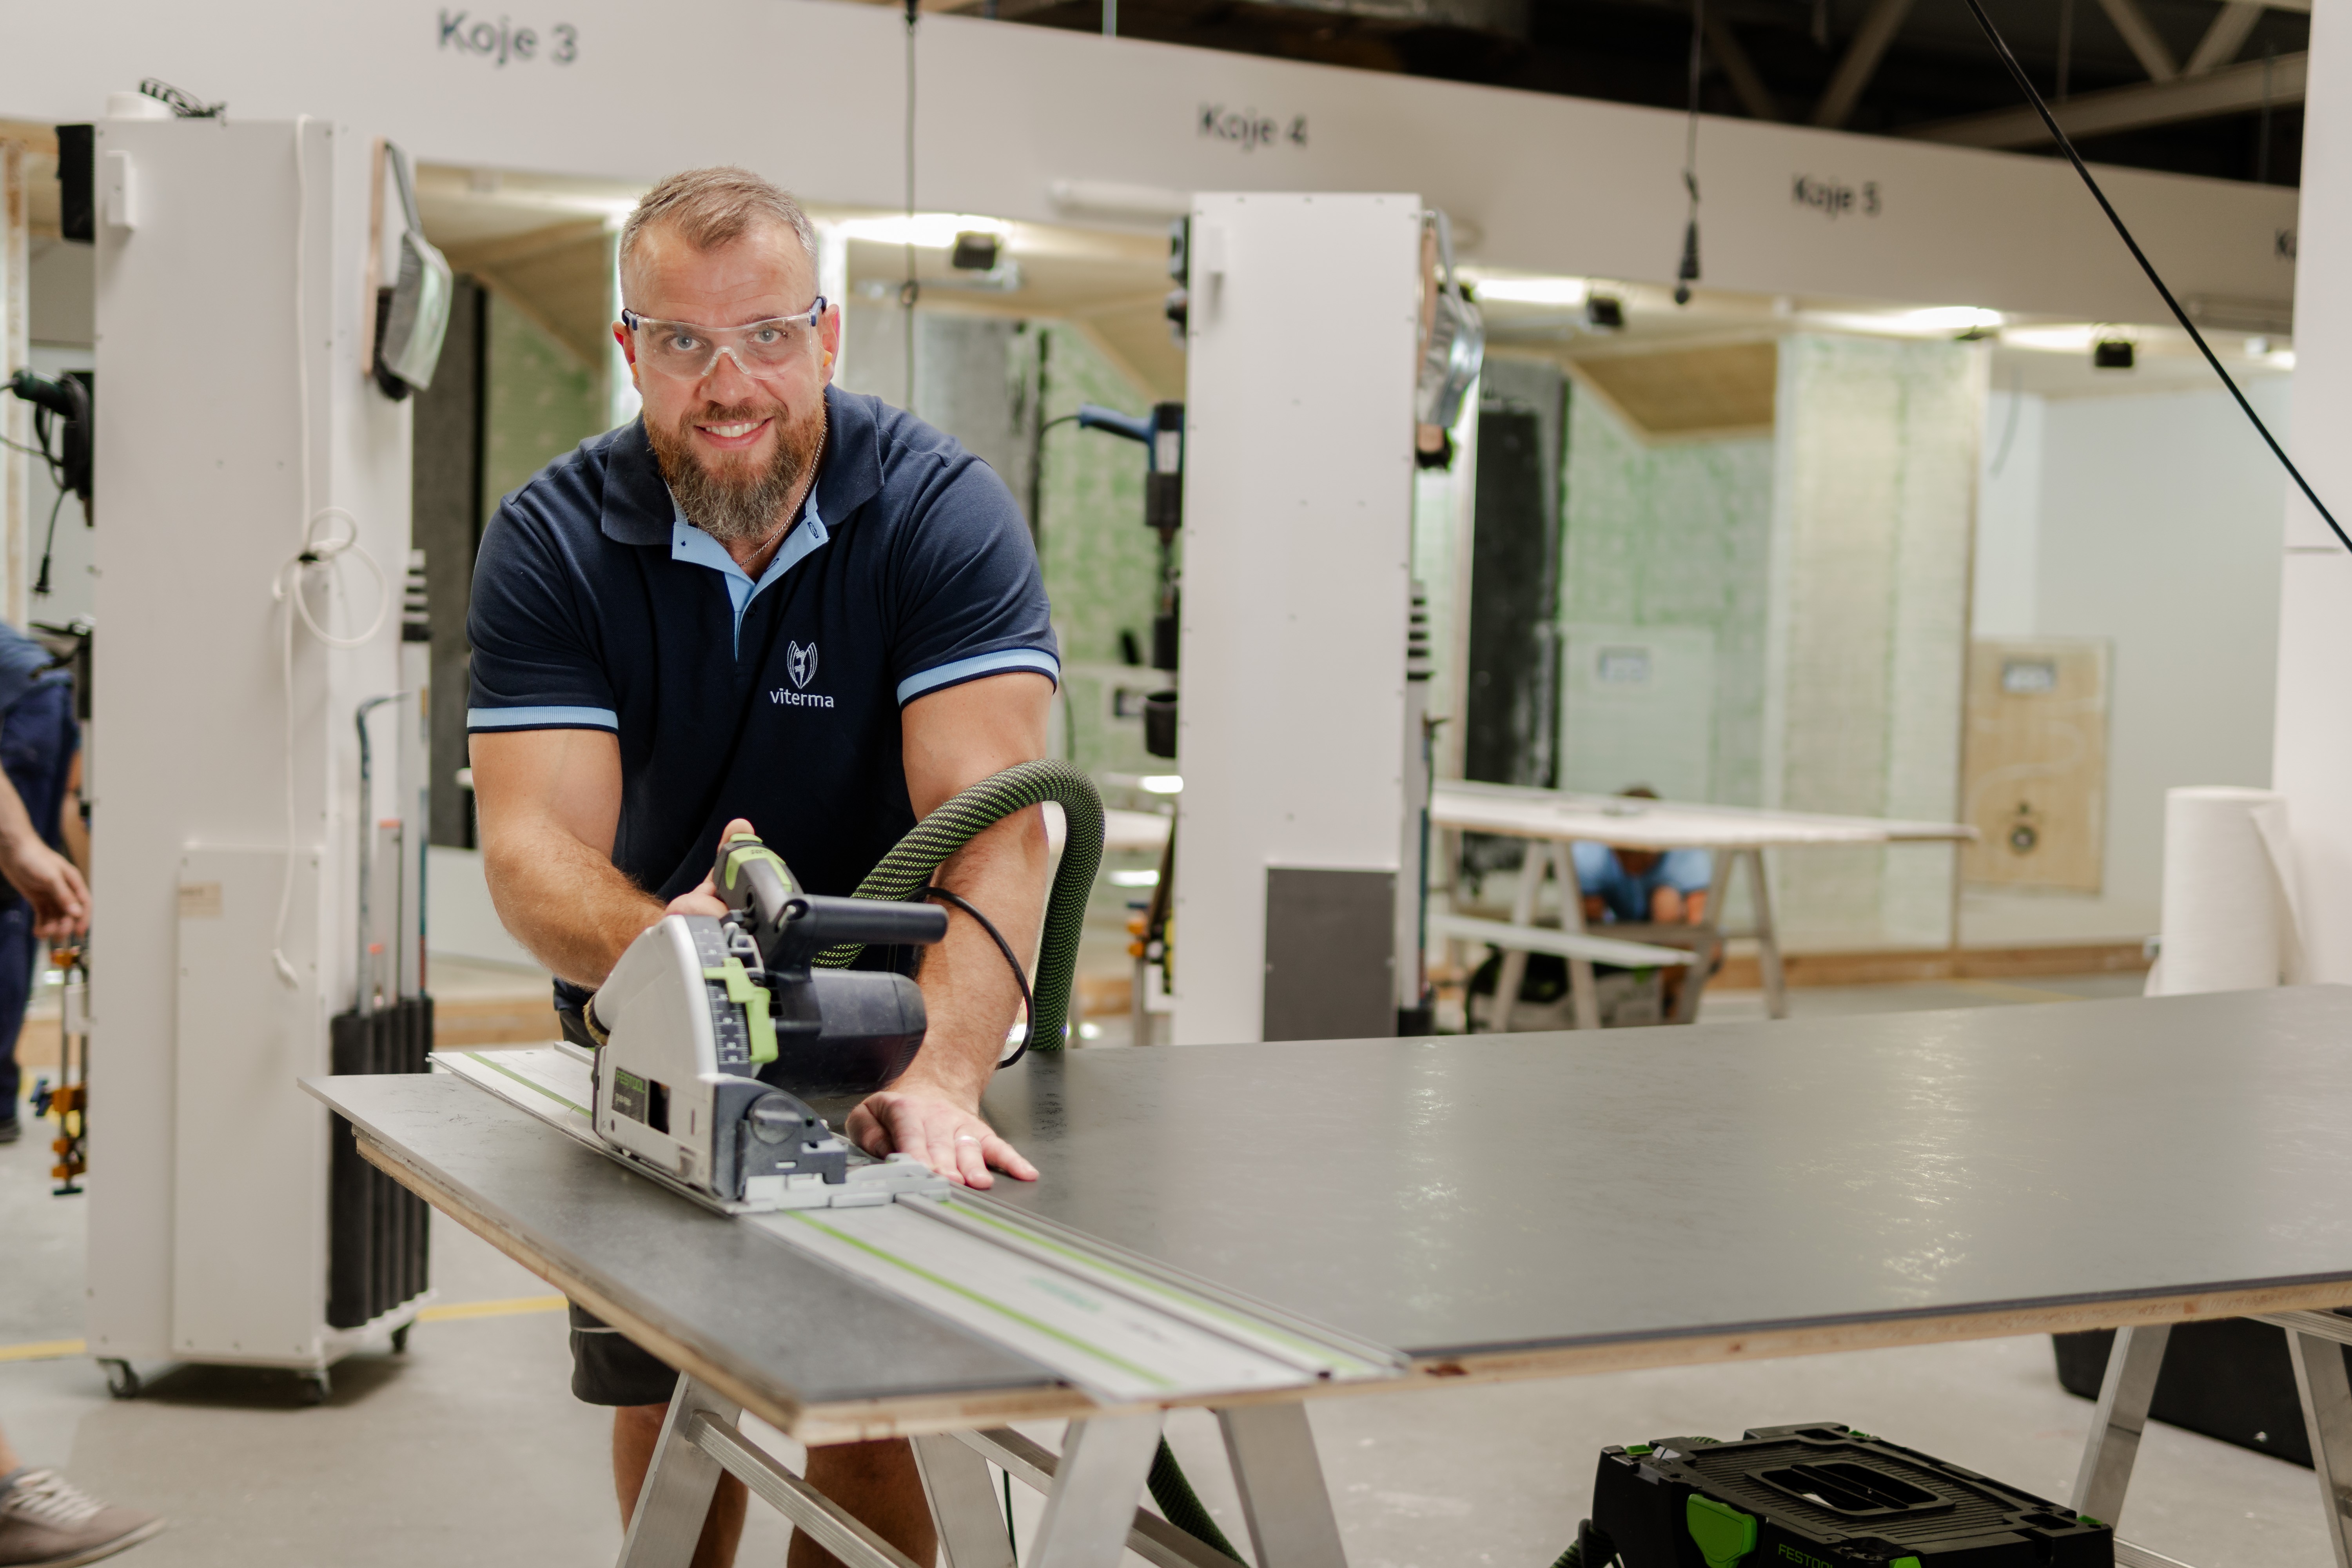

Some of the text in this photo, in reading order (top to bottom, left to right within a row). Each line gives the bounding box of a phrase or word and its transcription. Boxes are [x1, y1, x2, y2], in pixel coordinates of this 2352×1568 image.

[437, 9, 579, 68] Koje 3
[1198, 102, 1307, 153] Koje 4
[1791, 172, 1881, 222] Koje 5
[770, 688, 834, 708] viterma
[615, 1070, 646, 1094] FESTOOL
